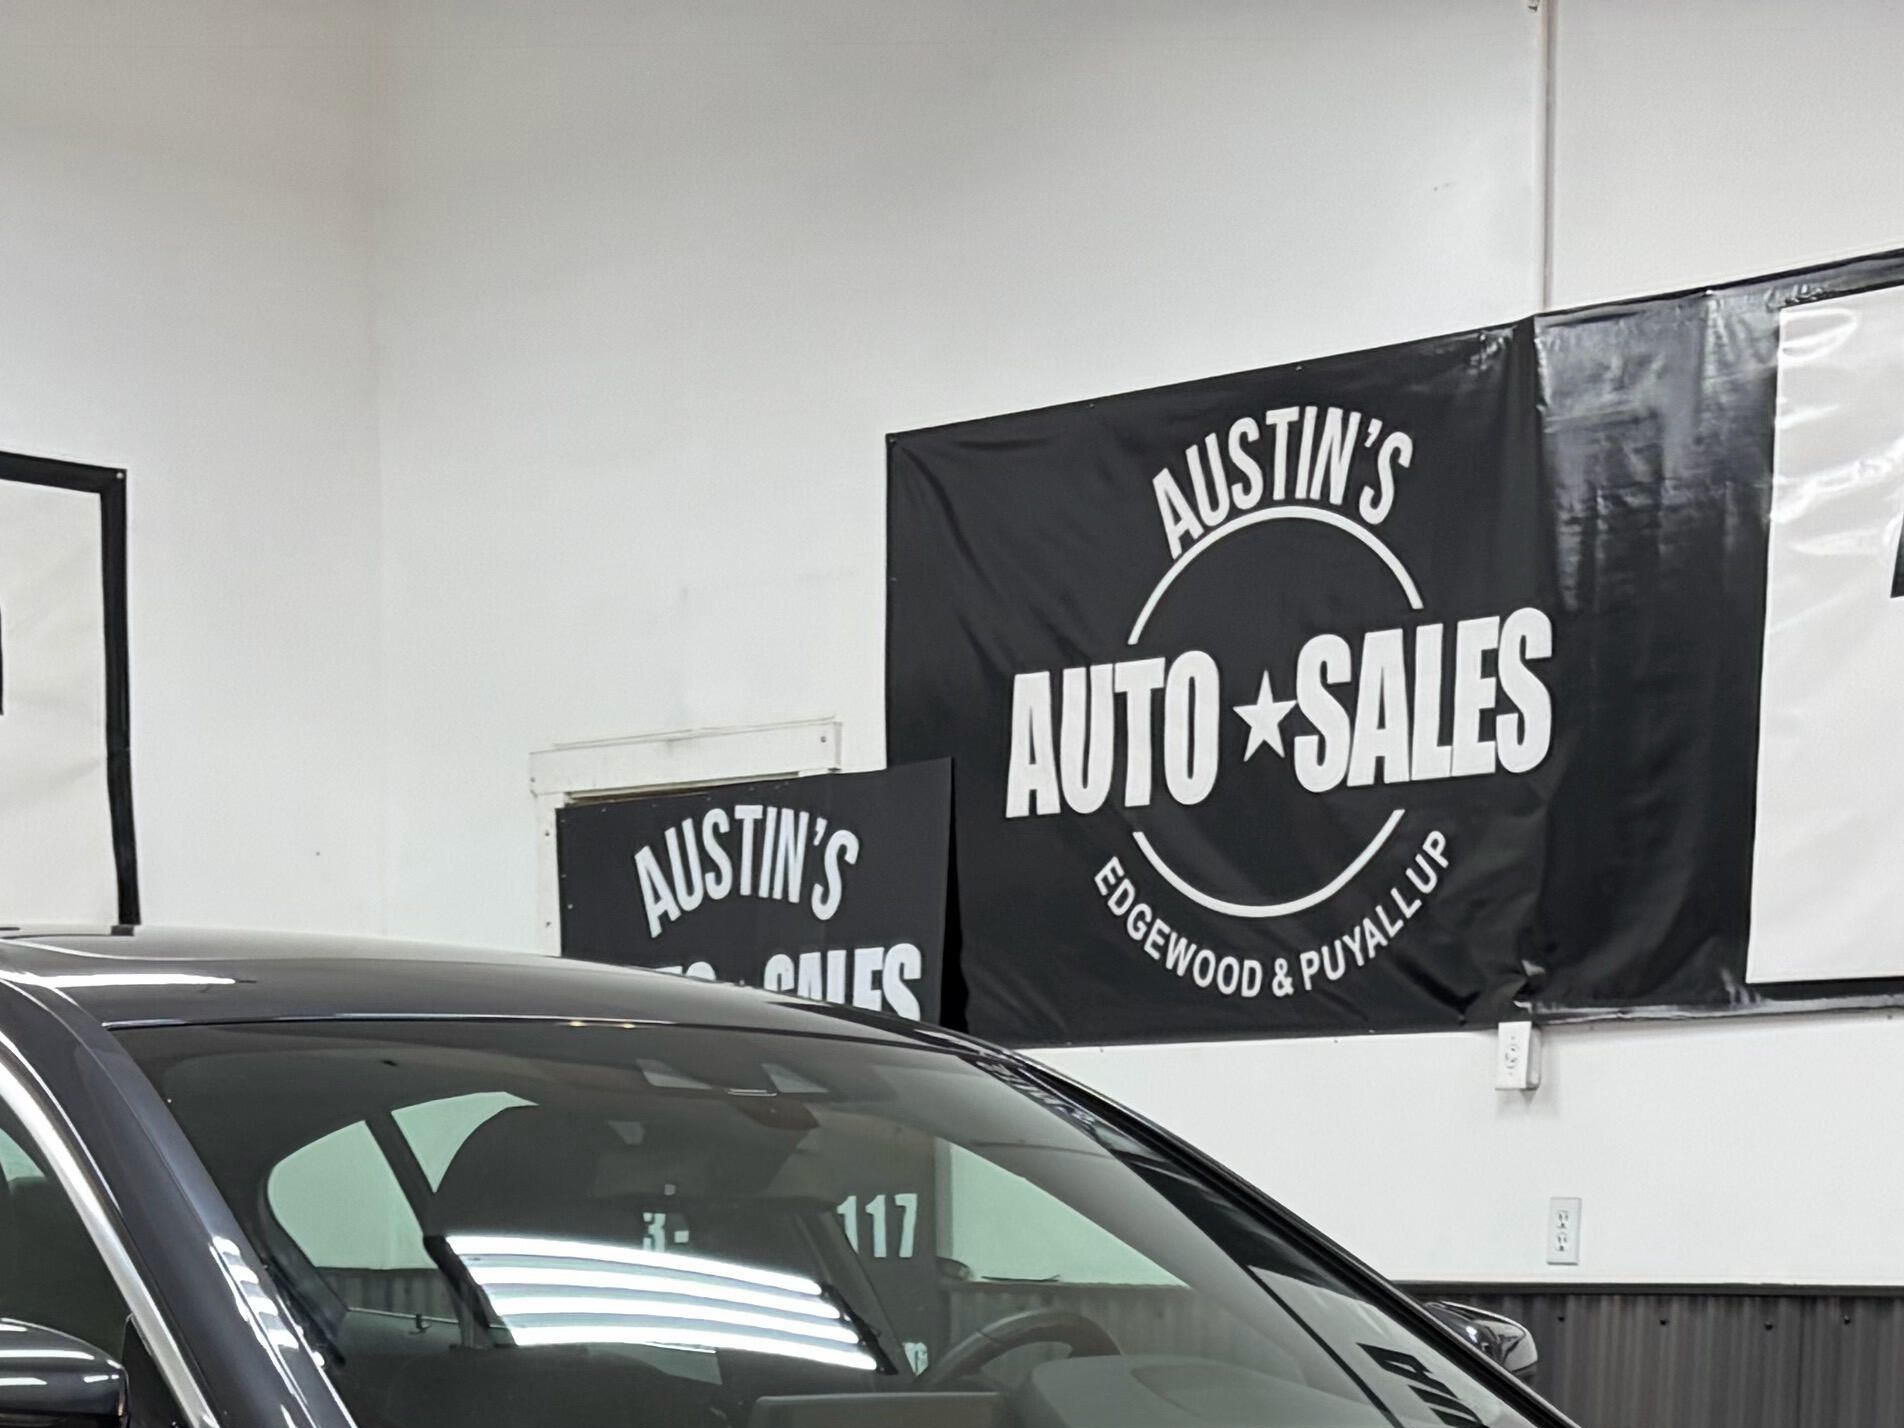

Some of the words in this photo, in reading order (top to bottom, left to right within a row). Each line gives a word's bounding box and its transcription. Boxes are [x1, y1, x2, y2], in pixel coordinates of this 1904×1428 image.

[1152, 405, 1413, 562] AUSTIN'S
[1005, 650, 1220, 818] AUTO
[1293, 607, 1552, 793] SALES
[634, 804, 859, 938] AUSTIN'S
[1094, 856, 1263, 998] EDGEWOOD
[1271, 957, 1294, 997] &
[1300, 830, 1449, 991] PUYALLUP
